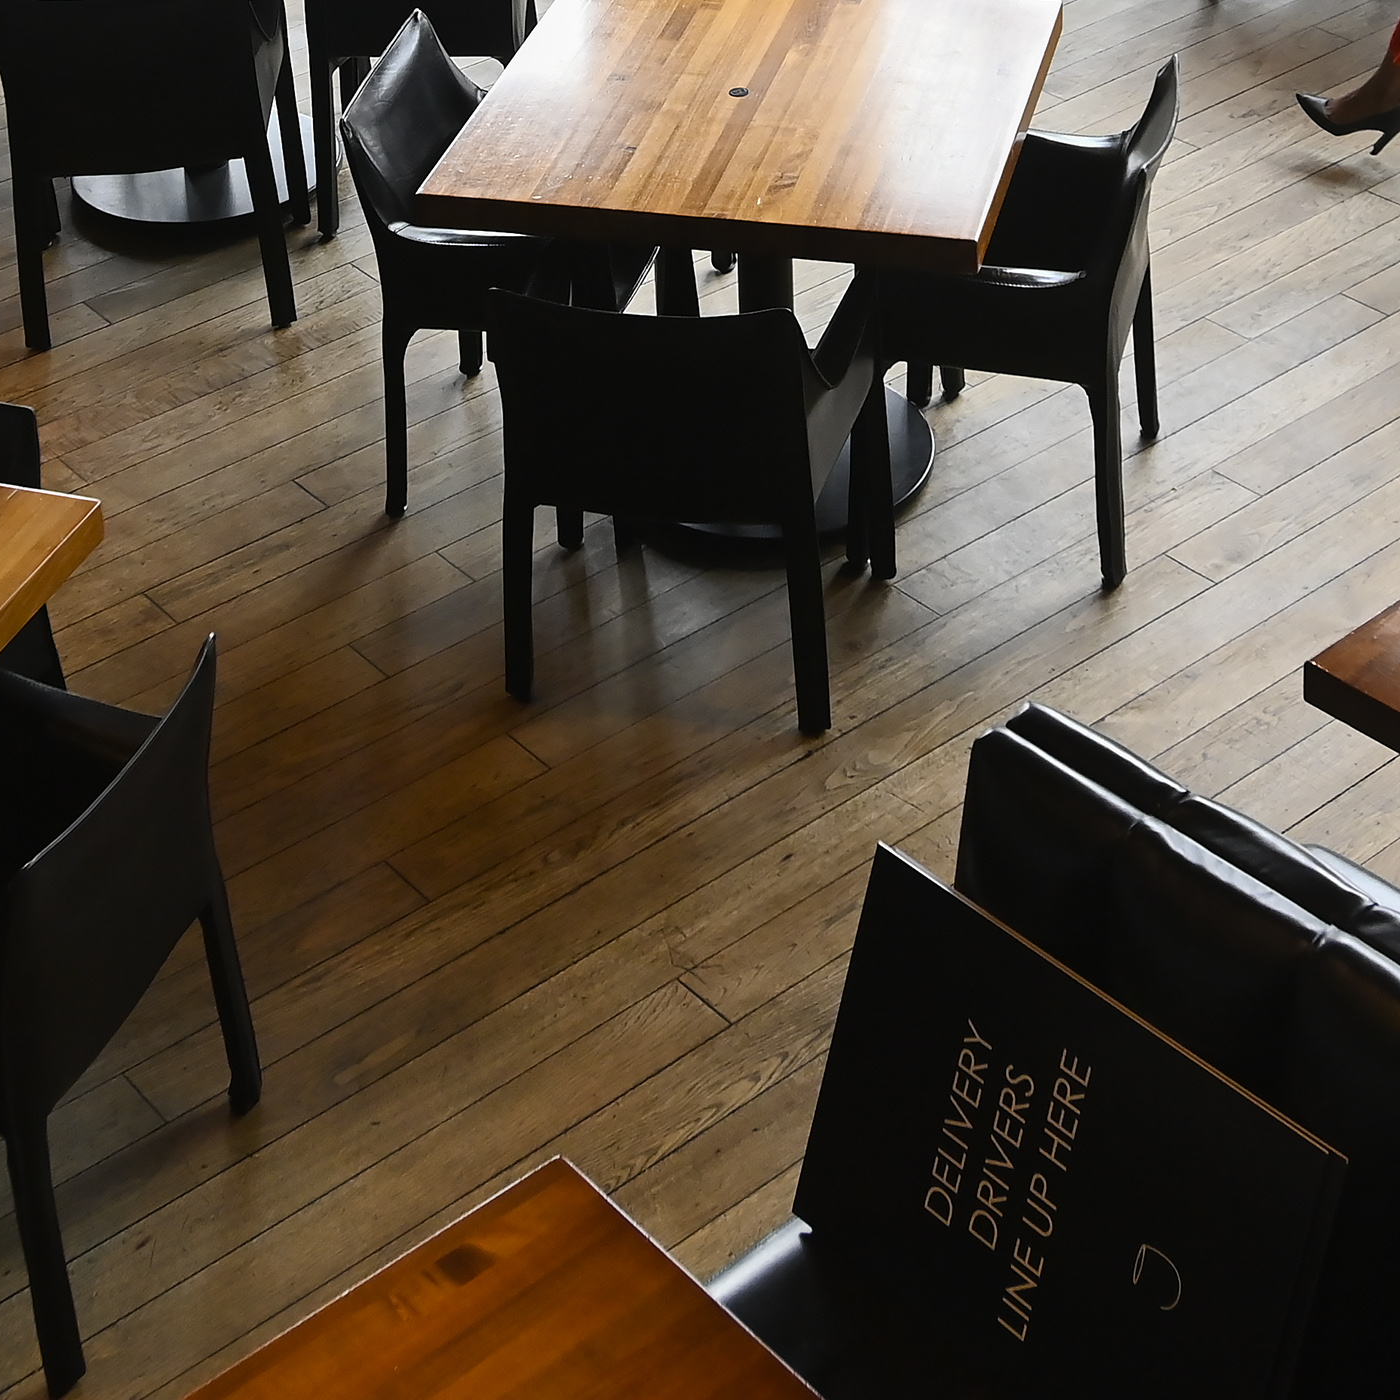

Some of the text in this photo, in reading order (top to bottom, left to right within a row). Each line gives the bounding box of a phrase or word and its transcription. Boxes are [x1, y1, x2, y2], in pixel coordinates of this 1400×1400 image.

[923, 1017, 993, 1227] DELIVERY
[968, 1064, 1035, 1251] DRIVERS
[997, 1047, 1092, 1342] LINE UP HERE
